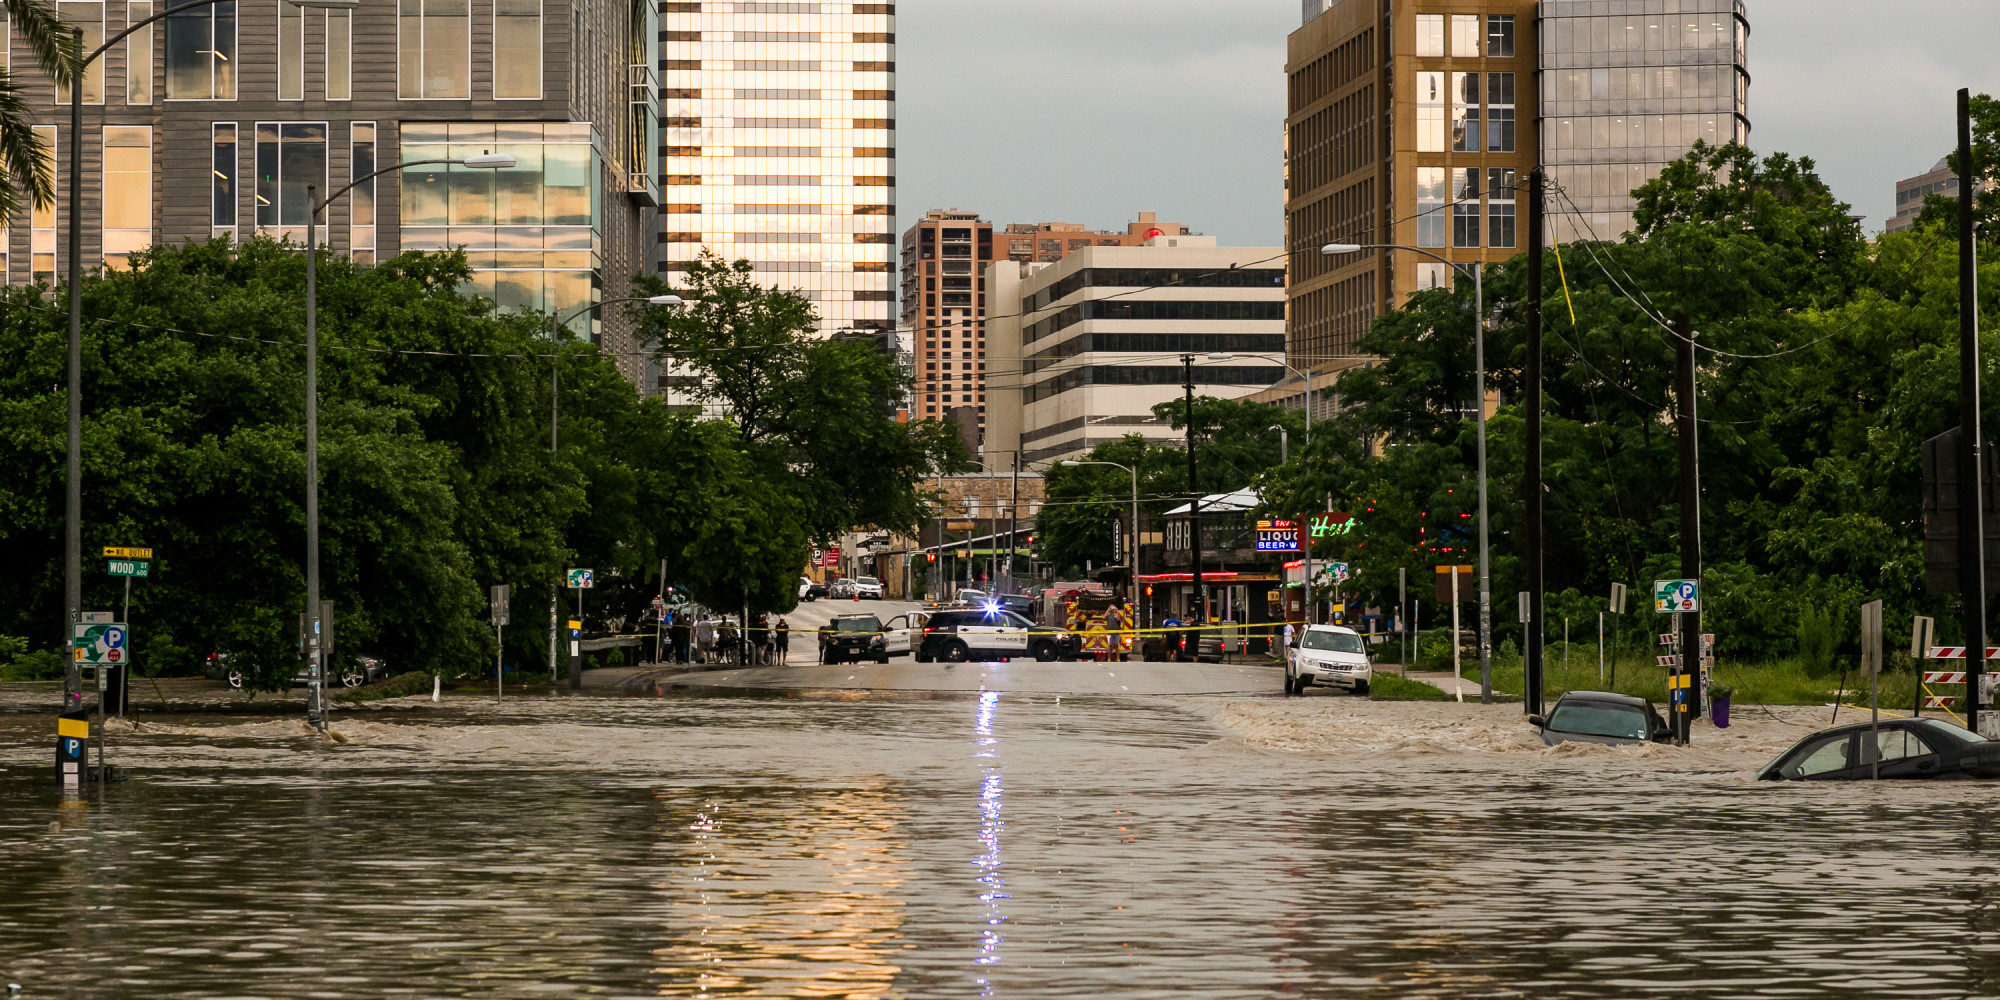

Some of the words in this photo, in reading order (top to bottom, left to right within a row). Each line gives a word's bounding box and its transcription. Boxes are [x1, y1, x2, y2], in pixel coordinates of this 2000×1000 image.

[115, 548, 125, 556] NO
[128, 548, 151, 557] OUTLET
[110, 562, 134, 574] WOOD
[1683, 585, 1692, 597] P
[109, 630, 121, 646] P
[69, 740, 78, 753] P
